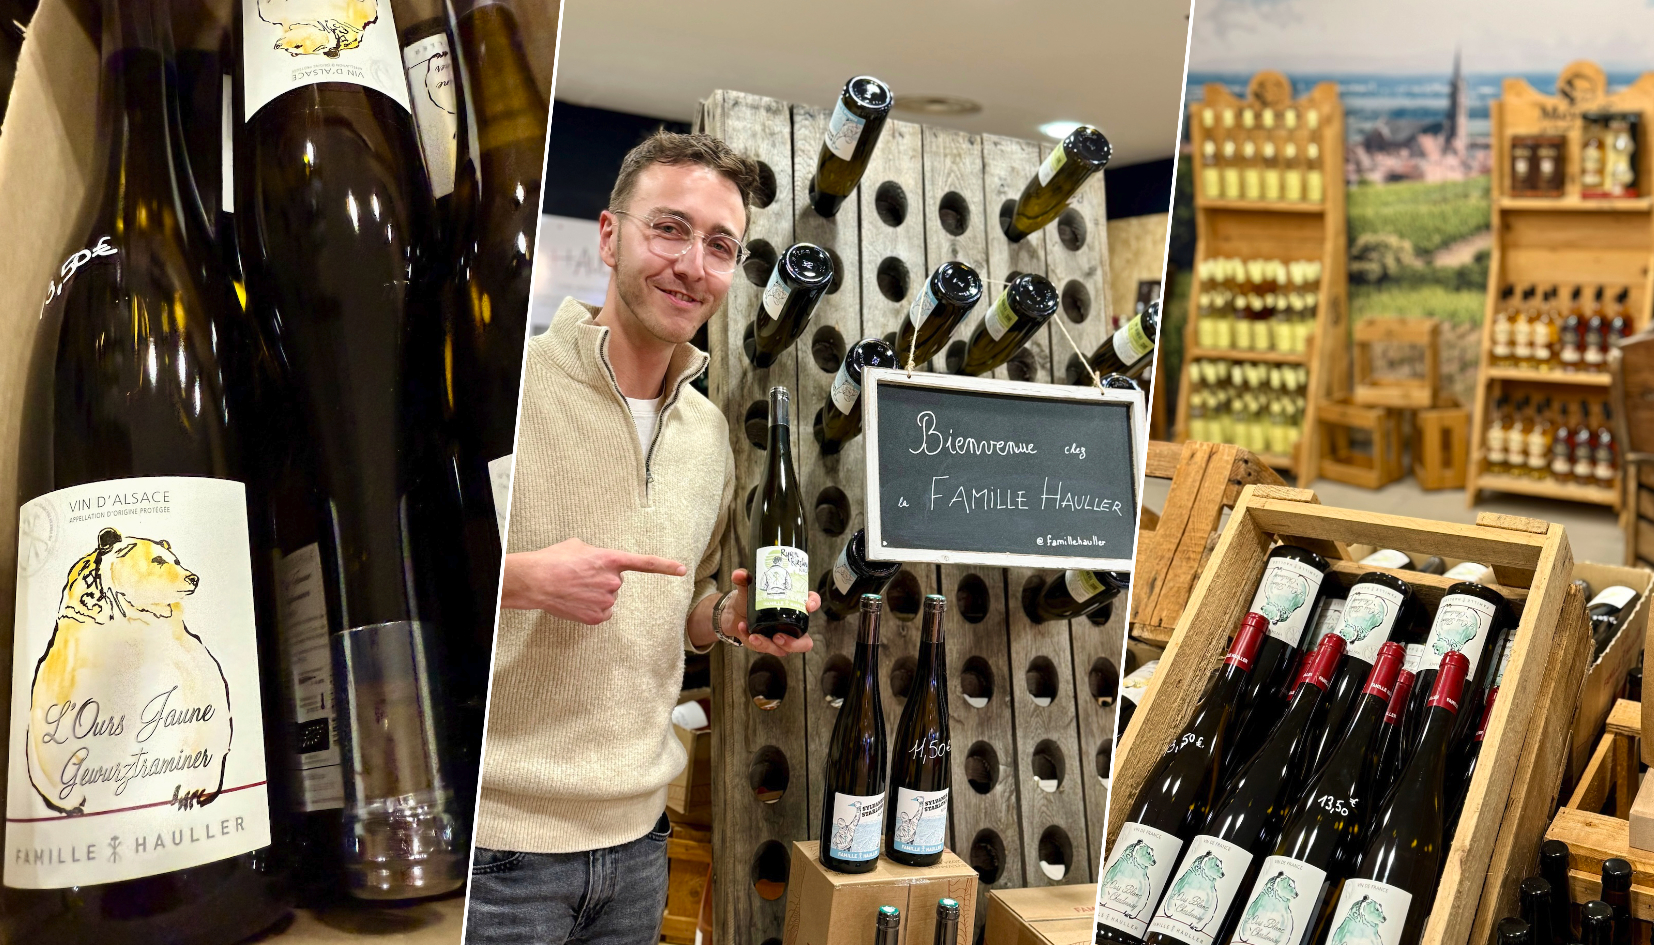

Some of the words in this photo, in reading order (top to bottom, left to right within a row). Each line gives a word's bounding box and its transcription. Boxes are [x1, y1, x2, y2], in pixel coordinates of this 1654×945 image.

[291, 67, 344, 82] D'ALSACE
[347, 69, 365, 79] VIN
[909, 410, 1037, 456] Bienvenue
[1064, 445, 1086, 459] chez
[69, 497, 91, 513] VIN
[97, 490, 170, 509] D'ALSACE
[1041, 476, 1123, 517] HAULLER
[69, 512, 105, 524] APPELLATION
[106, 507, 138, 518] D'ORIGINE
[42, 696, 125, 745] L'Ours
[136, 685, 216, 744] Jaune
[58, 746, 214, 801] Gewurztraminer
[1317, 794, 1359, 816] 13,50€
[15, 843, 97, 865] FAMILLE
[135, 815, 246, 855] HAULLER
[1371, 884, 1389, 894] FRANCE
[1110, 917, 1139, 932] HAULLER
